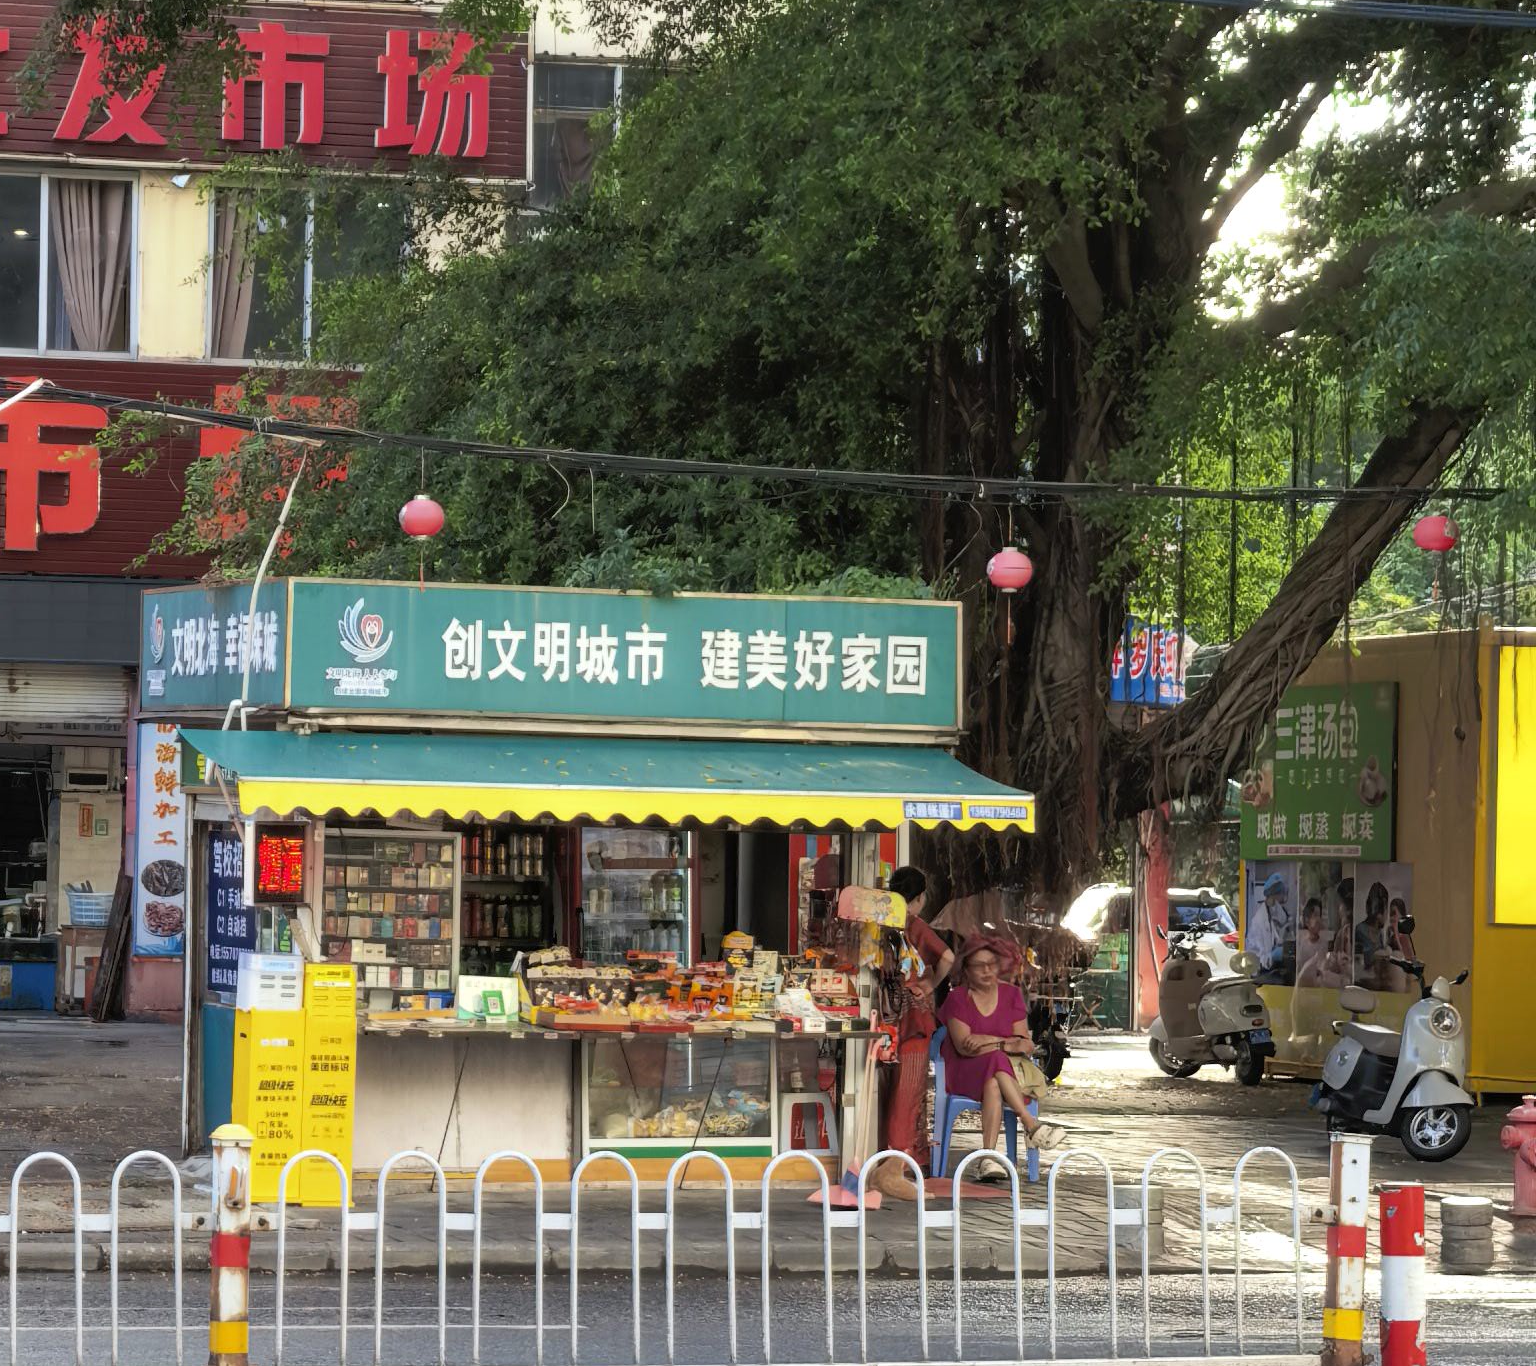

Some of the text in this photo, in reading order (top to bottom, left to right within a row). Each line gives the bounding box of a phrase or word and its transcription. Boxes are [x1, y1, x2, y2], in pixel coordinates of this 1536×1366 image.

[171, 616, 220, 676] 文明北海
[441, 617, 929, 696] 创文明城市 建美好家园
[153, 723, 180, 846] 海鲜加工
[268, 1130, 294, 1140] 80%
